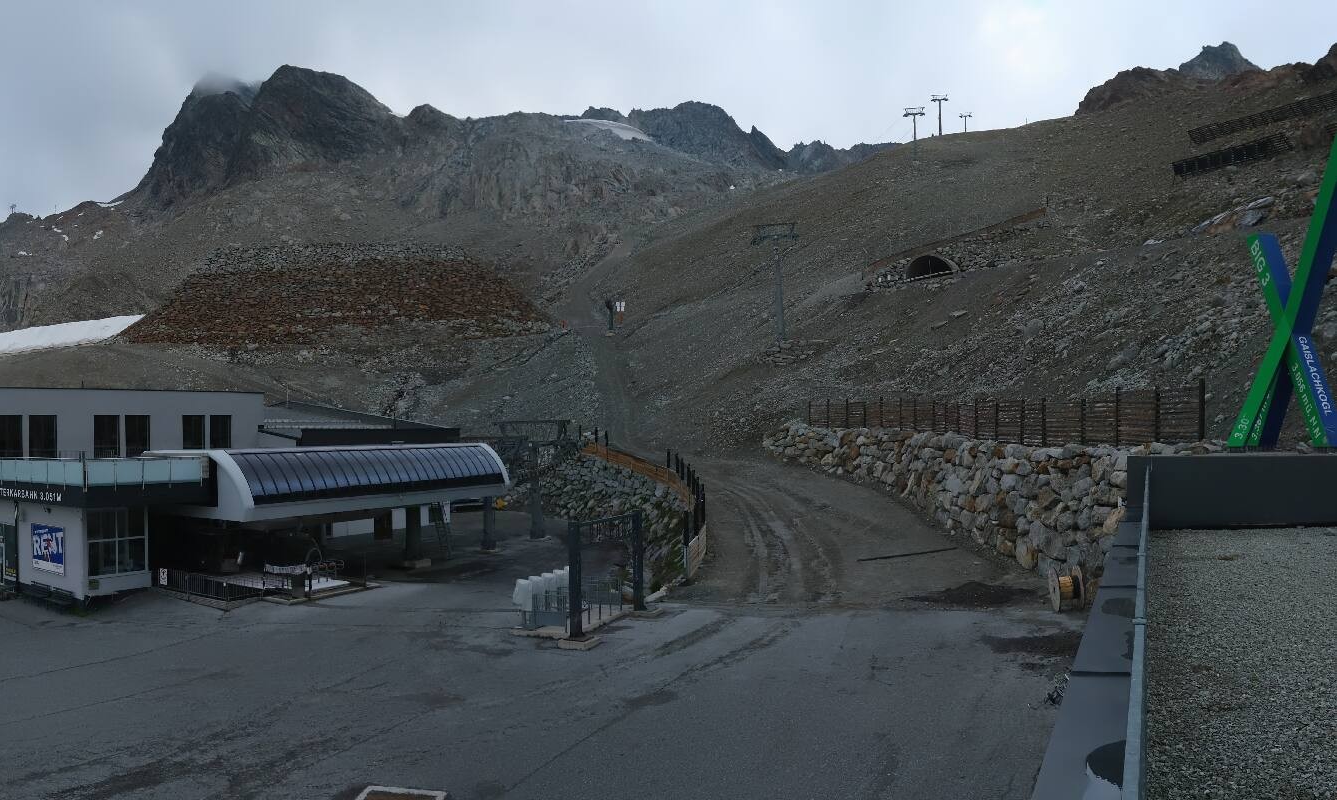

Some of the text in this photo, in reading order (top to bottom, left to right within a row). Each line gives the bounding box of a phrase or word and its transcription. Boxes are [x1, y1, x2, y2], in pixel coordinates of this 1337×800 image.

[1251, 239, 1271, 287] BIG 3
[1298, 336, 1333, 417] GAISLACHKOGL
[32, 532, 63, 556] RENT
